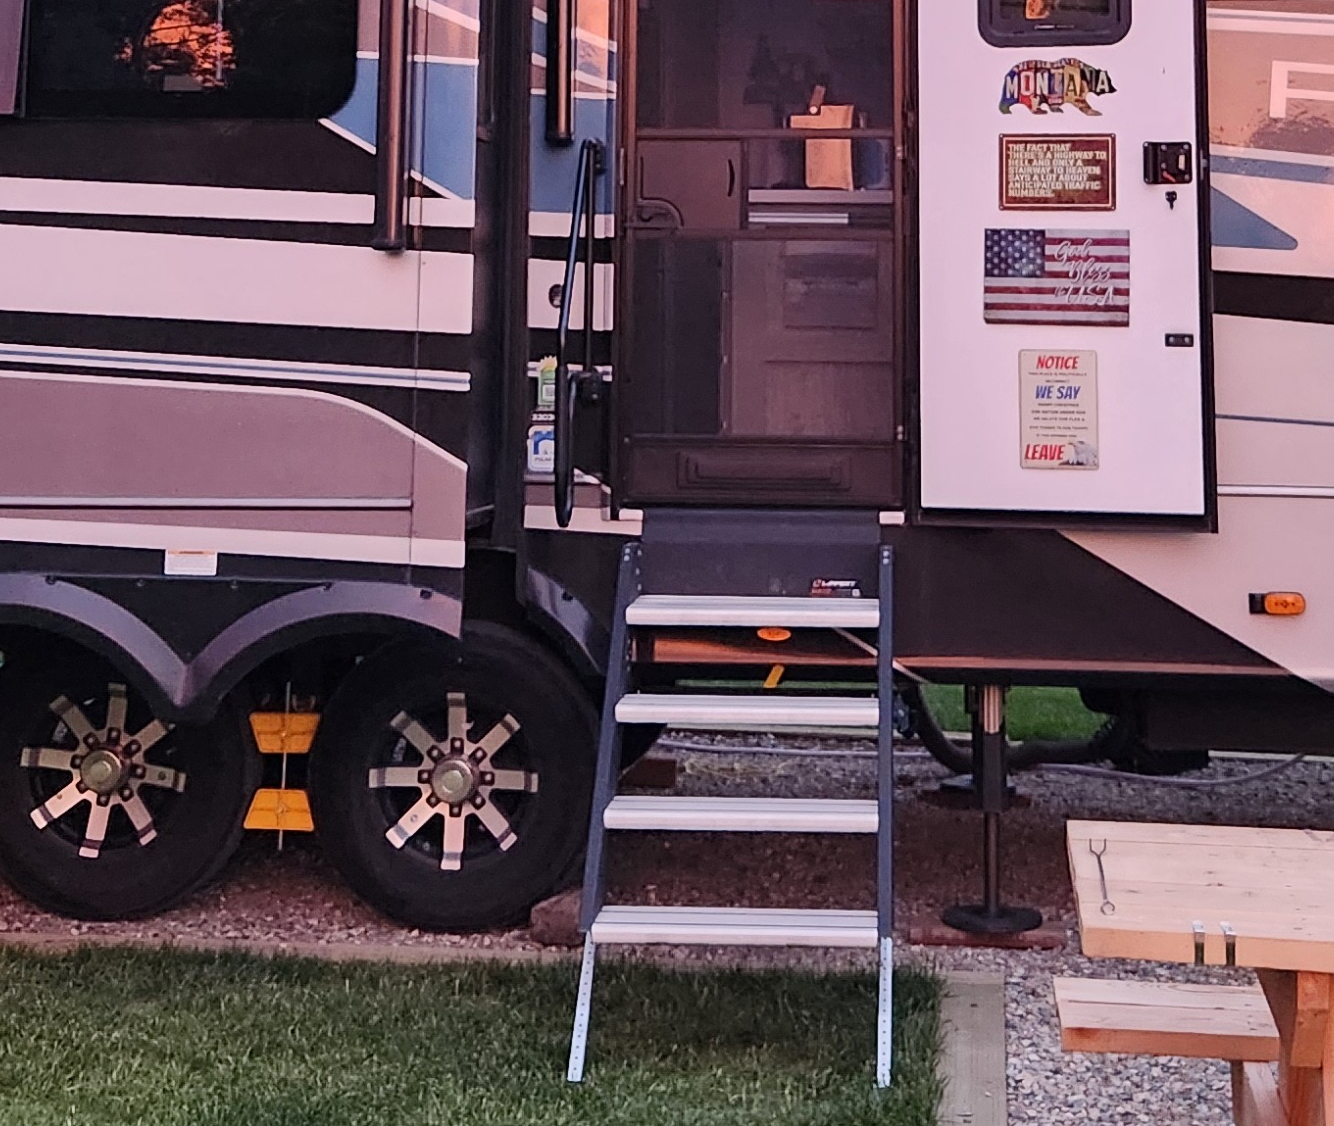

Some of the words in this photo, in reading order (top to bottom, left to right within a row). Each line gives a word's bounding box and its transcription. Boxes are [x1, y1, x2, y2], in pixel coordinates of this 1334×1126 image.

[1006, 69, 1110, 99] MONTANA
[1008, 143, 1025, 151] THE
[1027, 143, 1047, 151] FACT
[1049, 143, 1071, 151] THAT
[1054, 151, 1094, 159] HIGHWAY
[1096, 151, 1107, 159] TO
[1008, 166, 1051, 174] STAIRWAY
[1054, 166, 1064, 174] TO
[1067, 166, 1101, 174] HEAVEN
[1064, 181, 1101, 189] TRAFFIC
[1055, 239, 1092, 266] God
[1069, 258, 1111, 284] Bless
[1036, 356, 1079, 370] NOTICE
[1035, 385, 1054, 399] WE
[1056, 385, 1081, 399] SAY
[1024, 443, 1065, 461] LEAVE
